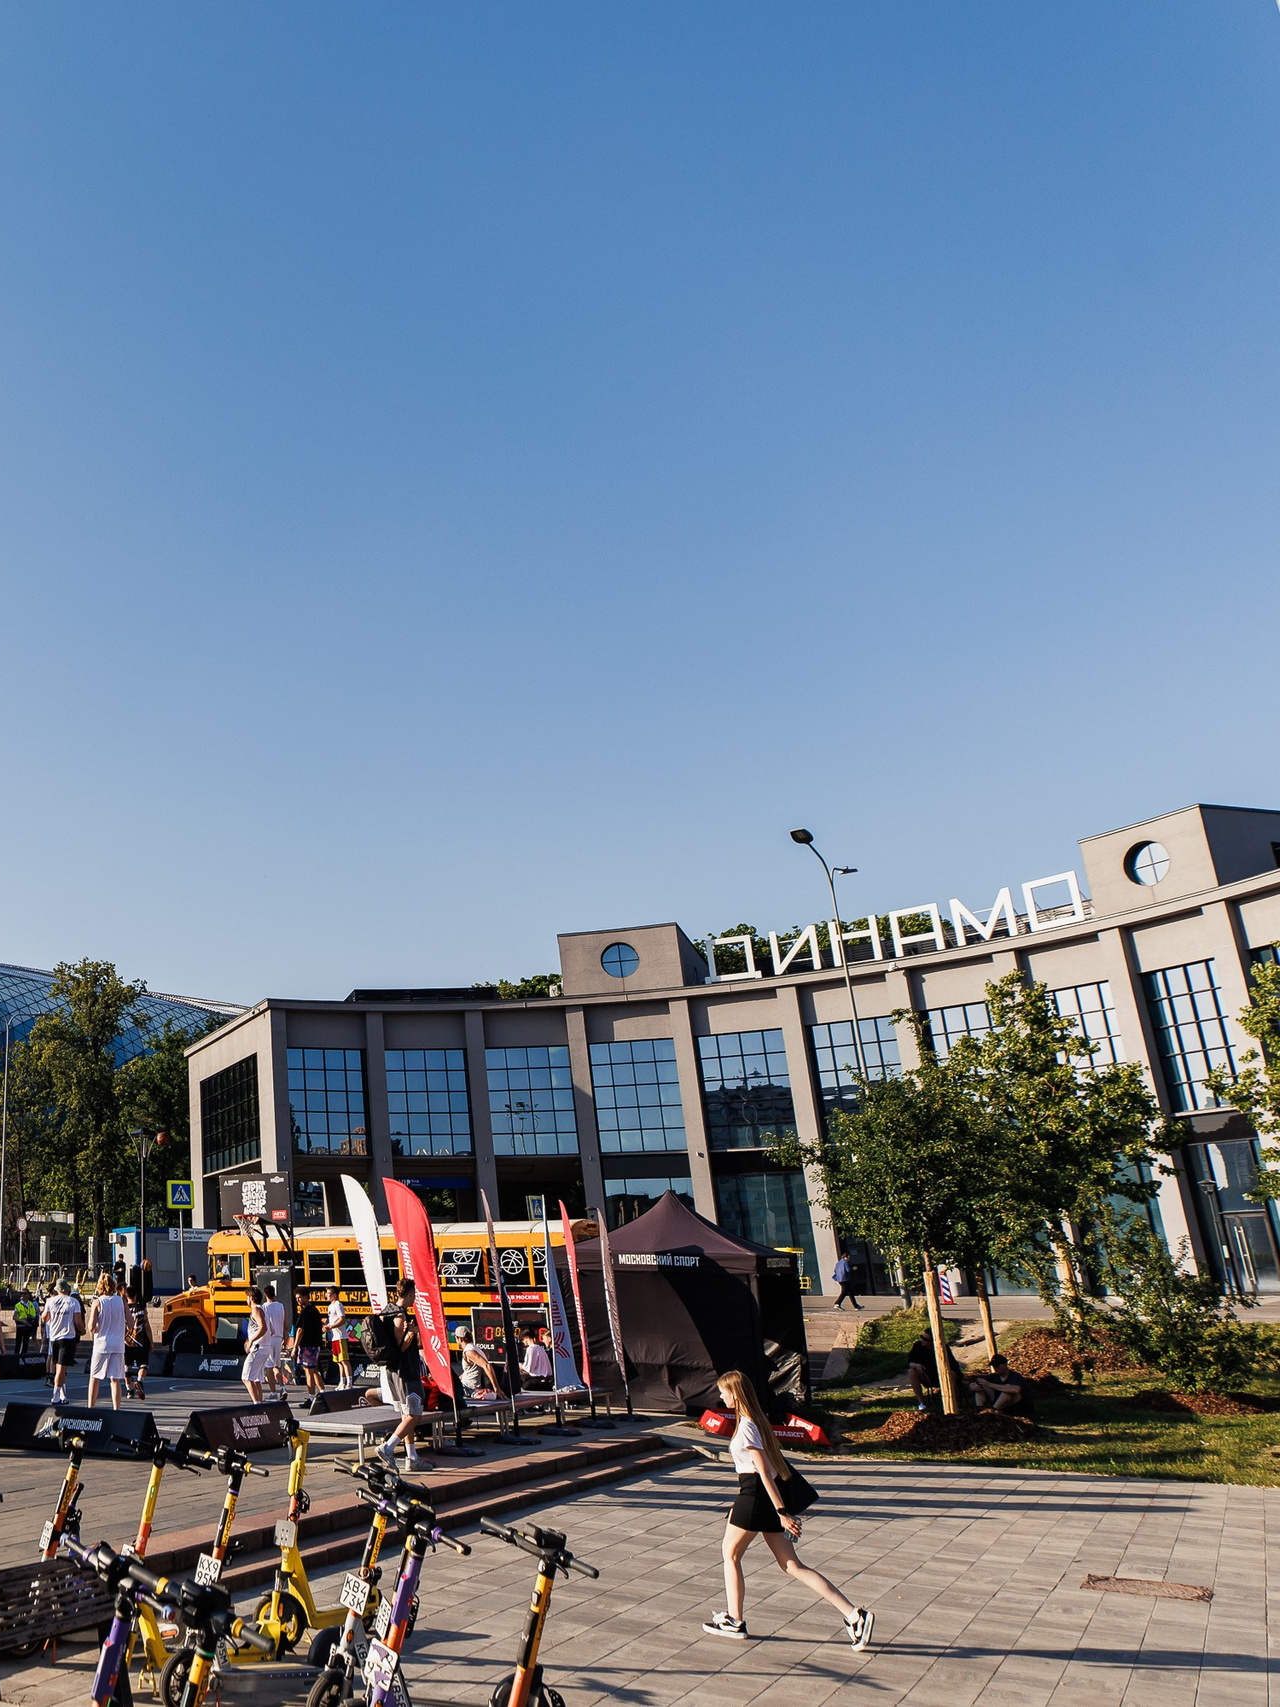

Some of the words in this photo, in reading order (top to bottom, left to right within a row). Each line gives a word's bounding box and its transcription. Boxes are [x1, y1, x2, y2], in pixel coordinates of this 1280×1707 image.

[705, 870, 1086, 984] ДИНАМО
[173, 1229, 179, 1240] 3
[618, 1253, 673, 1266] МОСКОВСКИЙ
[674, 1255, 700, 1267] СПОРТ
